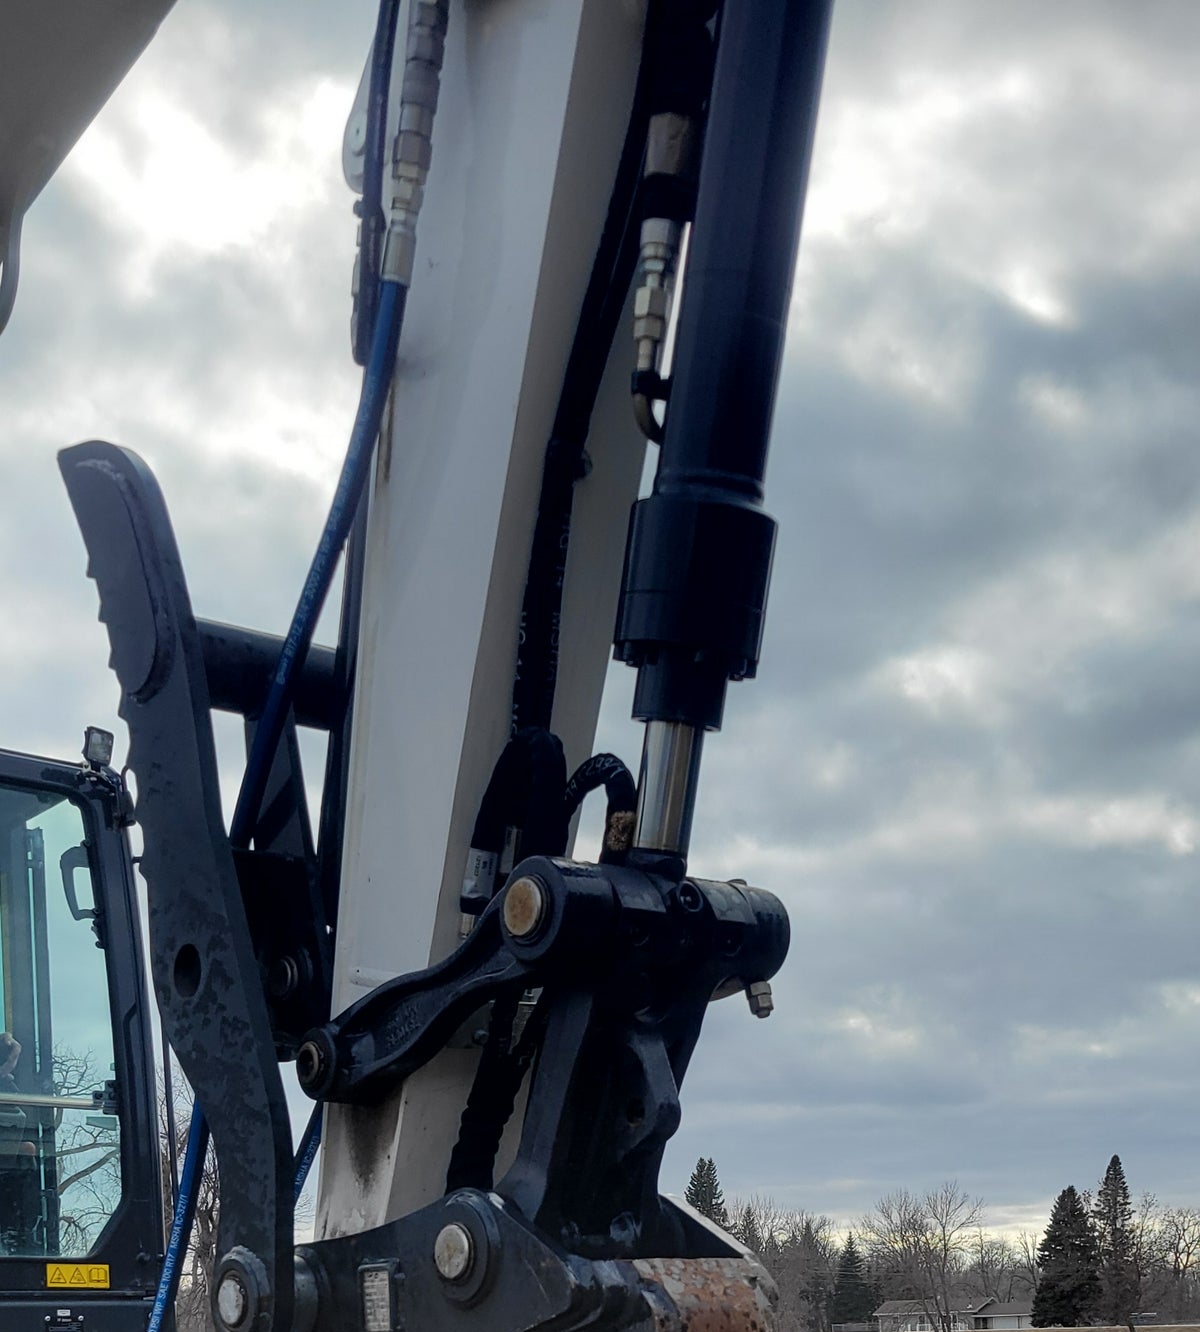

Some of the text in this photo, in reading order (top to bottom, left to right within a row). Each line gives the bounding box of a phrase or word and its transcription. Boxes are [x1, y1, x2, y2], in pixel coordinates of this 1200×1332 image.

[170, 1226, 182, 1249] MSHA
[166, 1253, 176, 1267] R17
[162, 1268, 172, 1282] 100
[159, 1284, 169, 1299] SAE
[155, 1303, 164, 1316] WP
[151, 1316, 160, 1329] PSI
